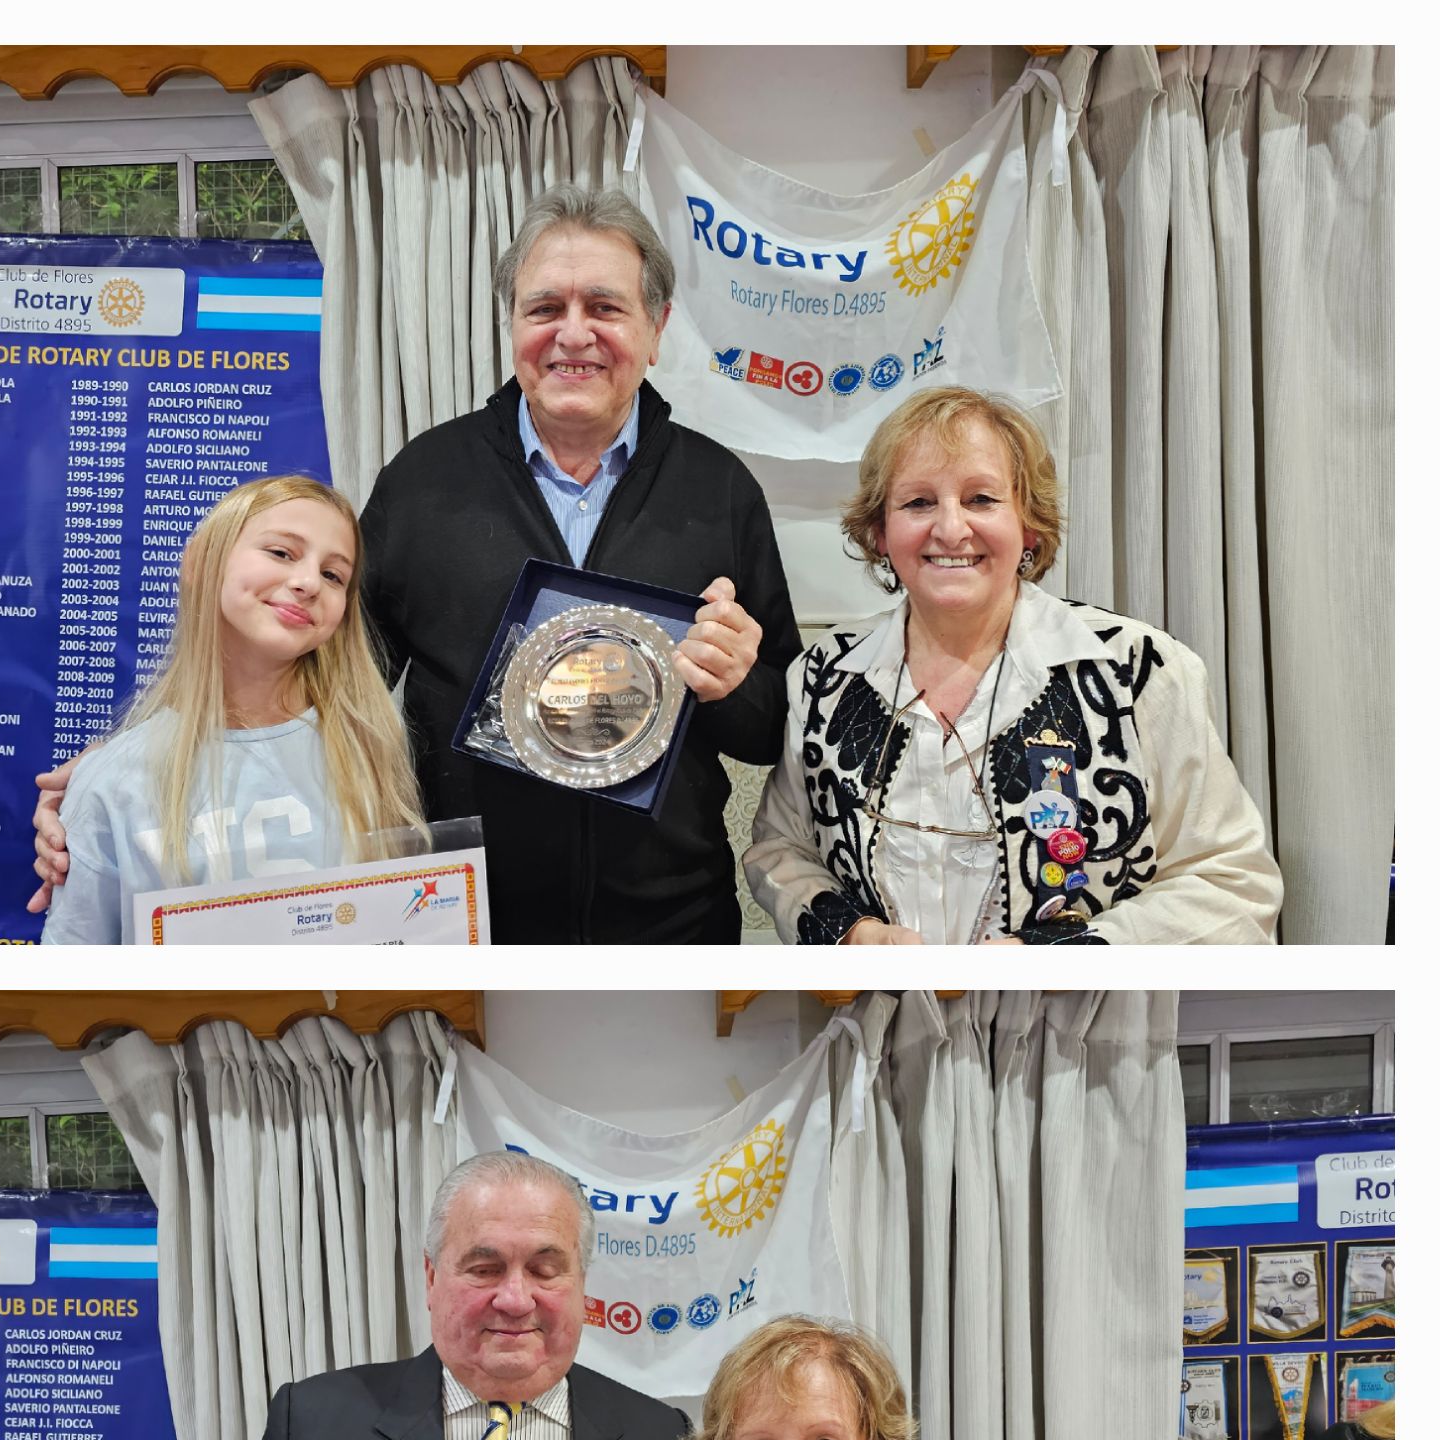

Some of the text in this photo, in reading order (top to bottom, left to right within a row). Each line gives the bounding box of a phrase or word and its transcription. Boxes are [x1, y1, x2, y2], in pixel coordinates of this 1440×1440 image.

[686, 195, 868, 282] Rotary
[33, 268, 49, 284] de
[53, 269, 93, 285] Flores
[14, 288, 92, 315] Rotary
[731, 280, 886, 316] Rotary Flores D.4895
[0, 316, 92, 332] Distrito 4895
[27, 346, 112, 367] ROTARY
[118, 348, 171, 368] CLUB
[177, 350, 205, 369] DE
[211, 351, 290, 371] FLORES
[719, 363, 744, 377] PEACE
[71, 379, 272, 395] 1989-1990 CARLOS JORDAN CRUZ
[547, 694, 586, 705] CARLOS
[296, 910, 332, 926] Rotary
[1329, 1157, 1367, 1172] Club
[597, 1233, 696, 1257] Flores D.4895
[32, 1298, 58, 1317] DE
[64, 1299, 139, 1318] FLORES
[5, 1402, 121, 1415] SAVERIO PANTALEONE
